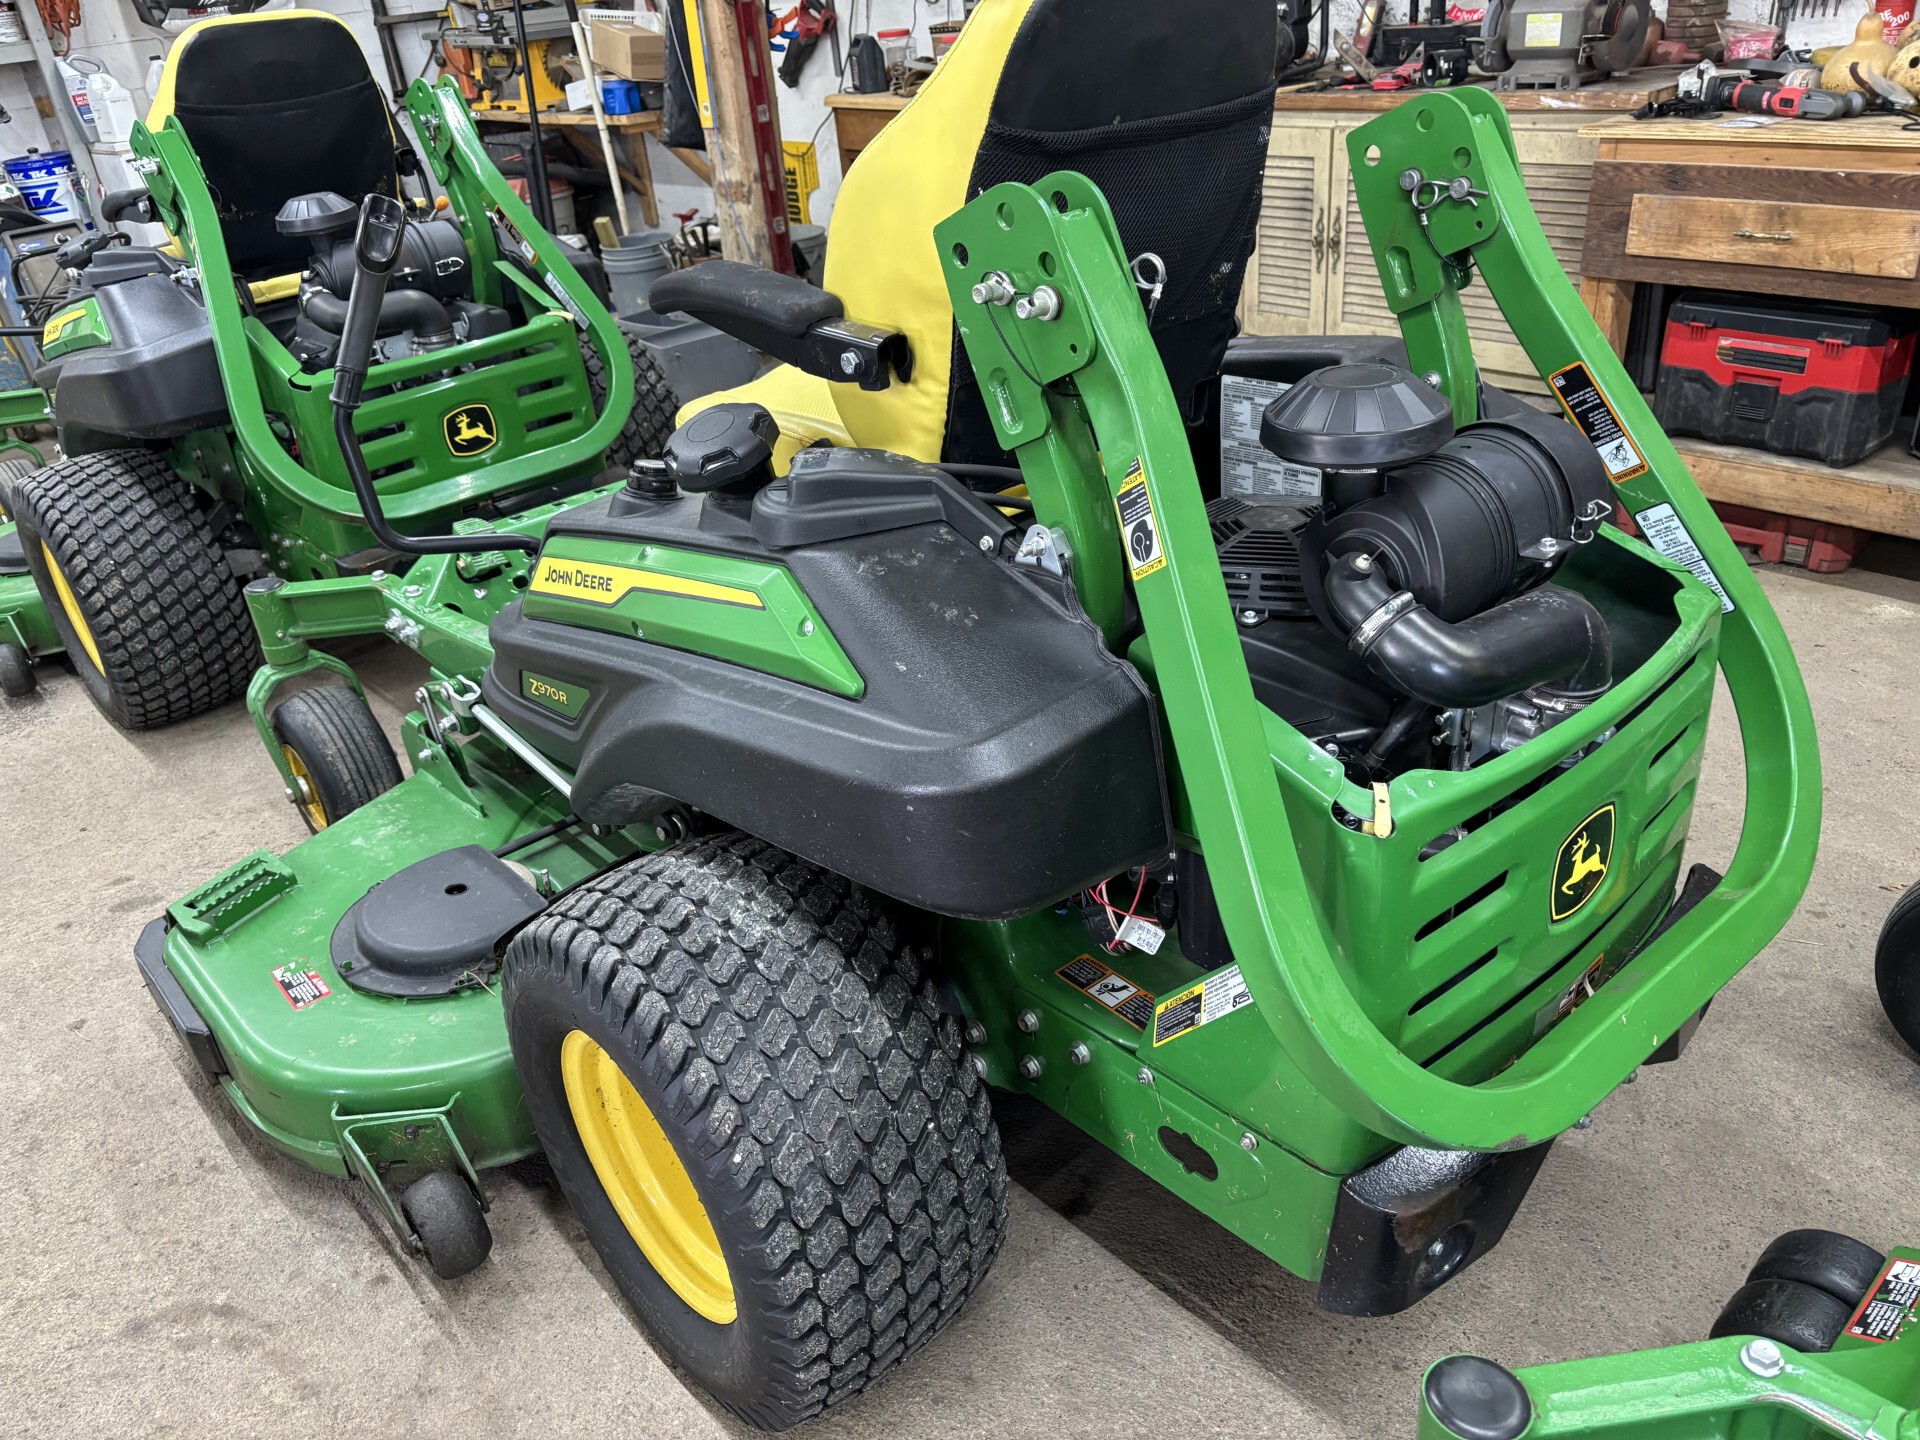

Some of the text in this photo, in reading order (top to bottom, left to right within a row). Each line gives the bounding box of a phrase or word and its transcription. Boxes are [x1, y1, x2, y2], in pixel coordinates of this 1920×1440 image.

[1890, 11, 1910, 28] 200
[28, 169, 49, 179] TK
[52, 165, 70, 175] TK
[1613, 467, 1640, 482] WARNING
[1135, 562, 1159, 577] CAUTION
[545, 565, 614, 593] JOHN DEERE
[529, 678, 569, 705] Z970R
